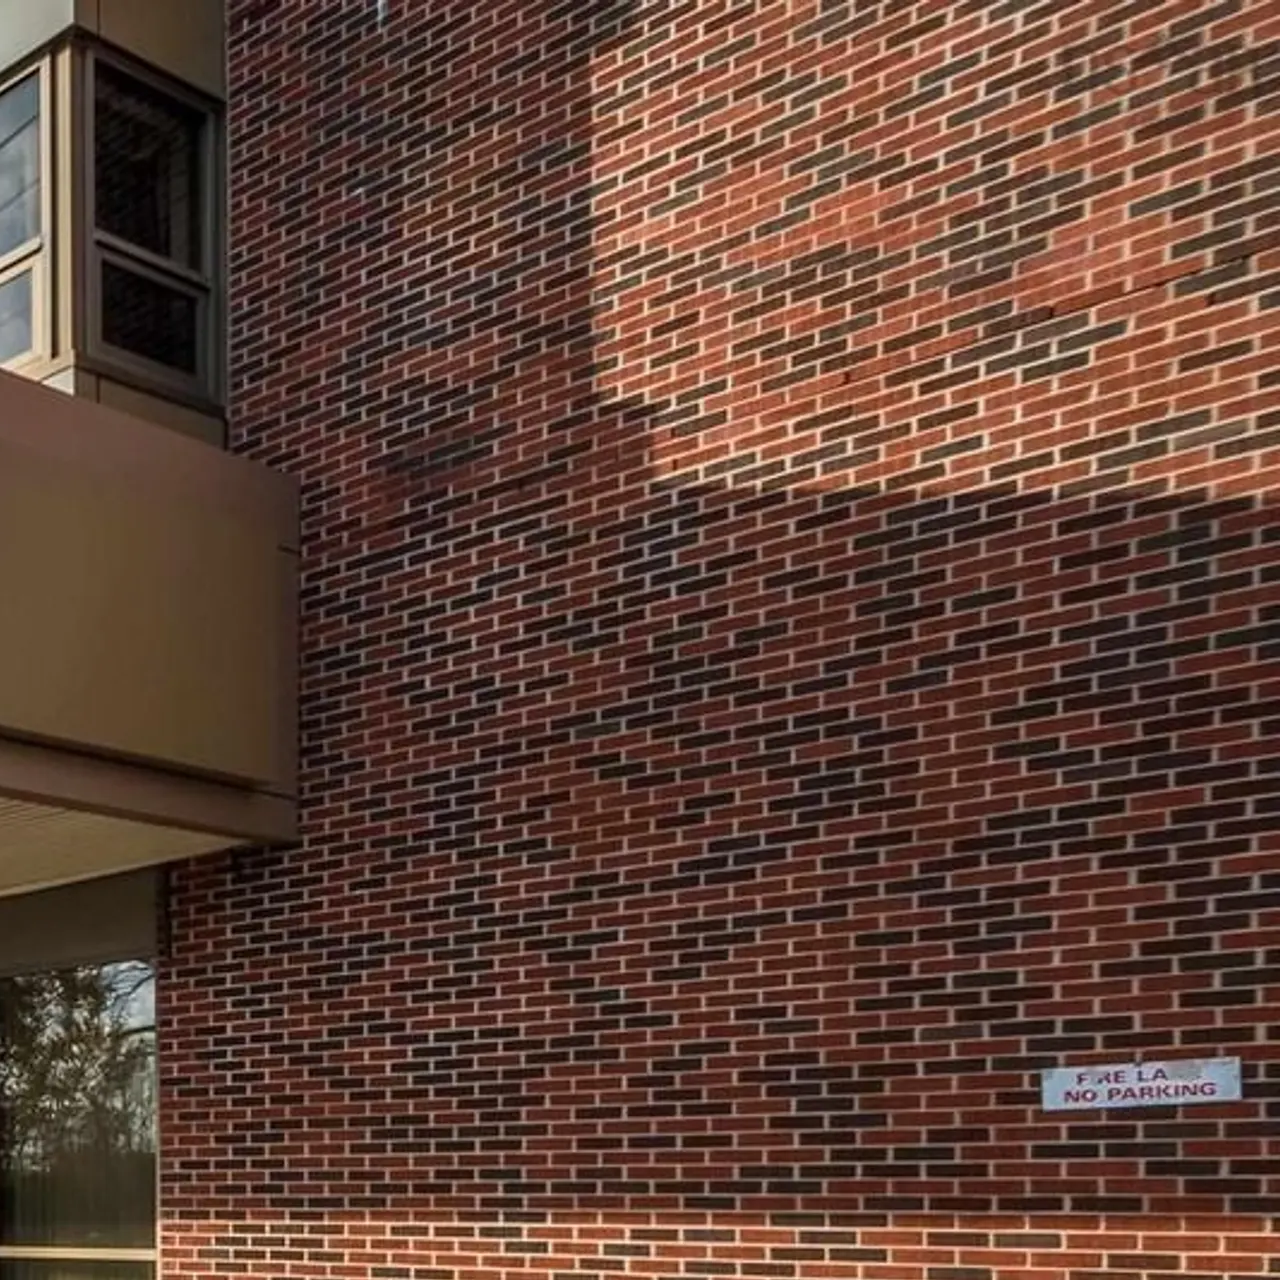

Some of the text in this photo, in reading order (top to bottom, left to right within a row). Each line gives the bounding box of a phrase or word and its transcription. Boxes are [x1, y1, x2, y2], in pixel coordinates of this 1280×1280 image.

[1076, 1070, 1126, 1085] FRE
[1063, 1082, 1217, 1103] NO PARKING
